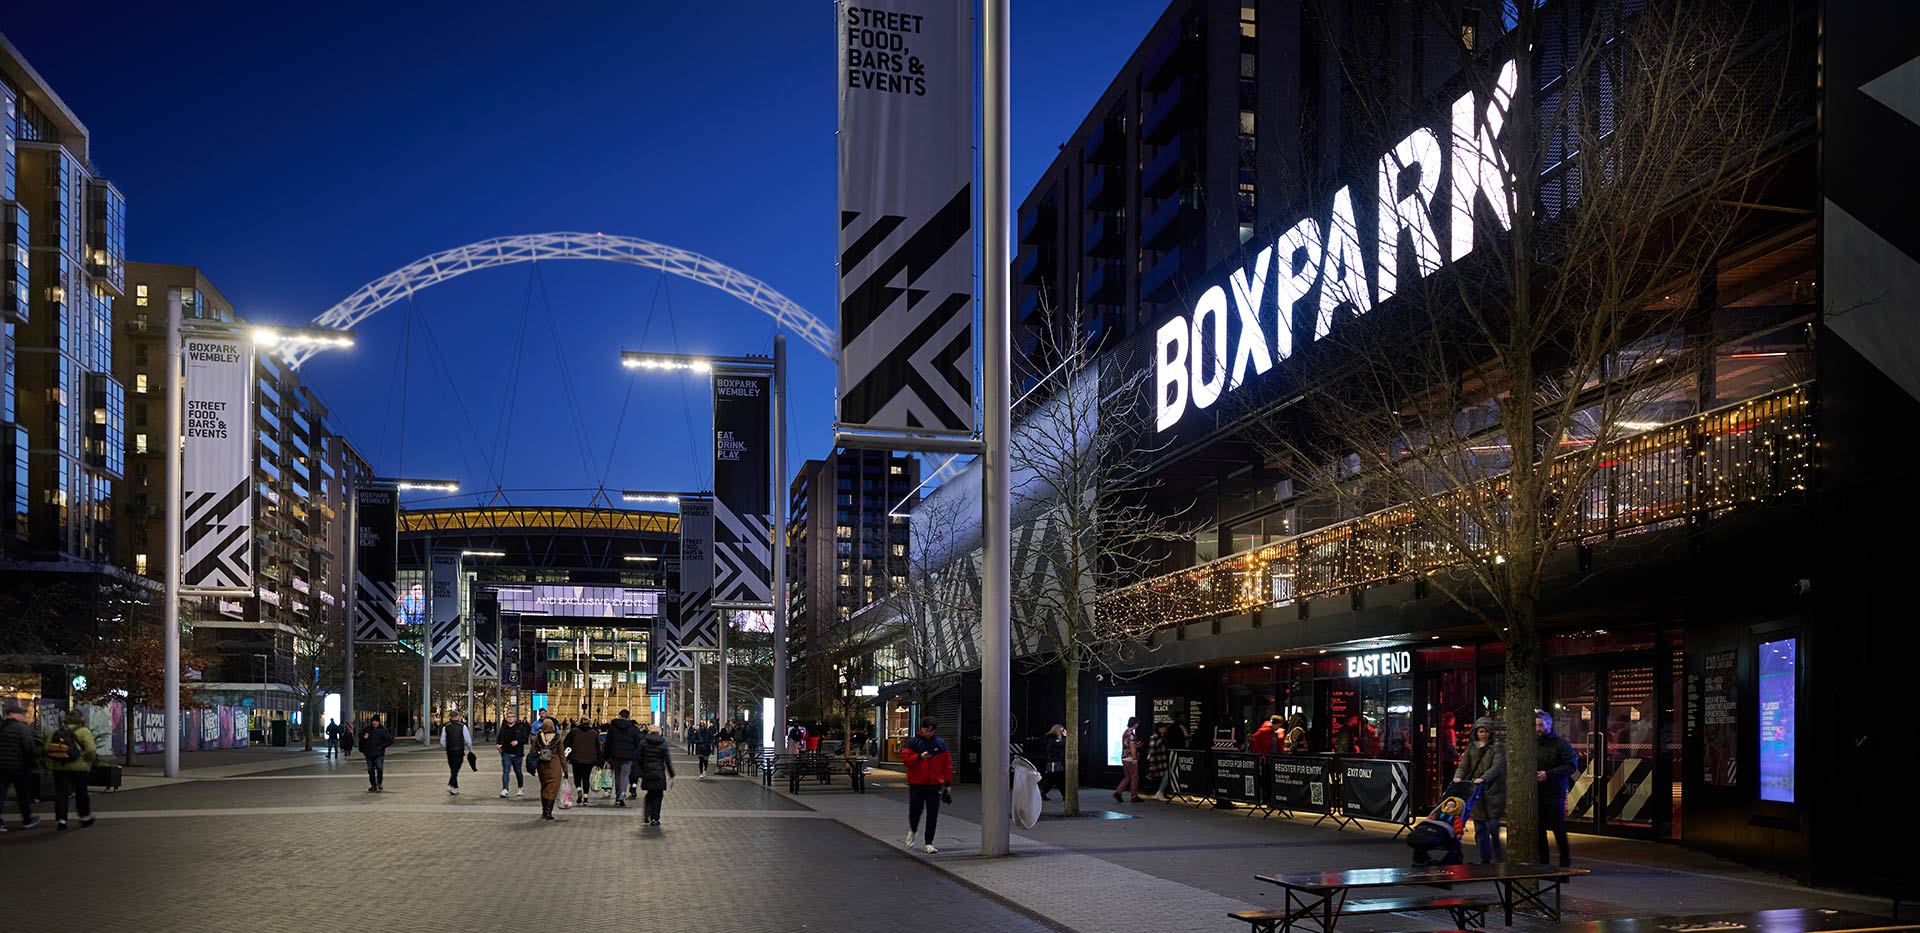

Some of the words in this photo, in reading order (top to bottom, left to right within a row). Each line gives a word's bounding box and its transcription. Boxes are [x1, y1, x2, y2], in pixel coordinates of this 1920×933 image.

[848, 7, 923, 33] STREET
[849, 28, 909, 55] FOOD,
[849, 48, 903, 72] BARS
[908, 56, 924, 76] &
[849, 69, 926, 96] EVENTS
[1156, 58, 1520, 433] BOXPARK
[190, 343, 237, 354] BOXPARK
[190, 352, 240, 363] WEMBLEY
[717, 379, 757, 389] BOXPARK
[717, 387, 760, 397] WEMBLEY
[189, 401, 226, 411] STREET
[189, 410, 219, 421] FOOD,
[189, 419, 216, 429] BARS
[218, 421, 227, 429] &
[189, 428, 227, 439] EVENTS
[536, 597, 556, 605] AND
[613, 599, 650, 607] EVENTS.
[1347, 654, 1380, 678] EAST
[1381, 651, 1411, 676] END
[1217, 759, 1234, 767] REGISTER
[1274, 763, 1296, 773] REGISTER
[1296, 765, 1306, 774] FOR
[1306, 766, 1322, 775] ENTRY
[1347, 768, 1359, 777] EXIT
[1359, 769, 1373, 779] ONLY
